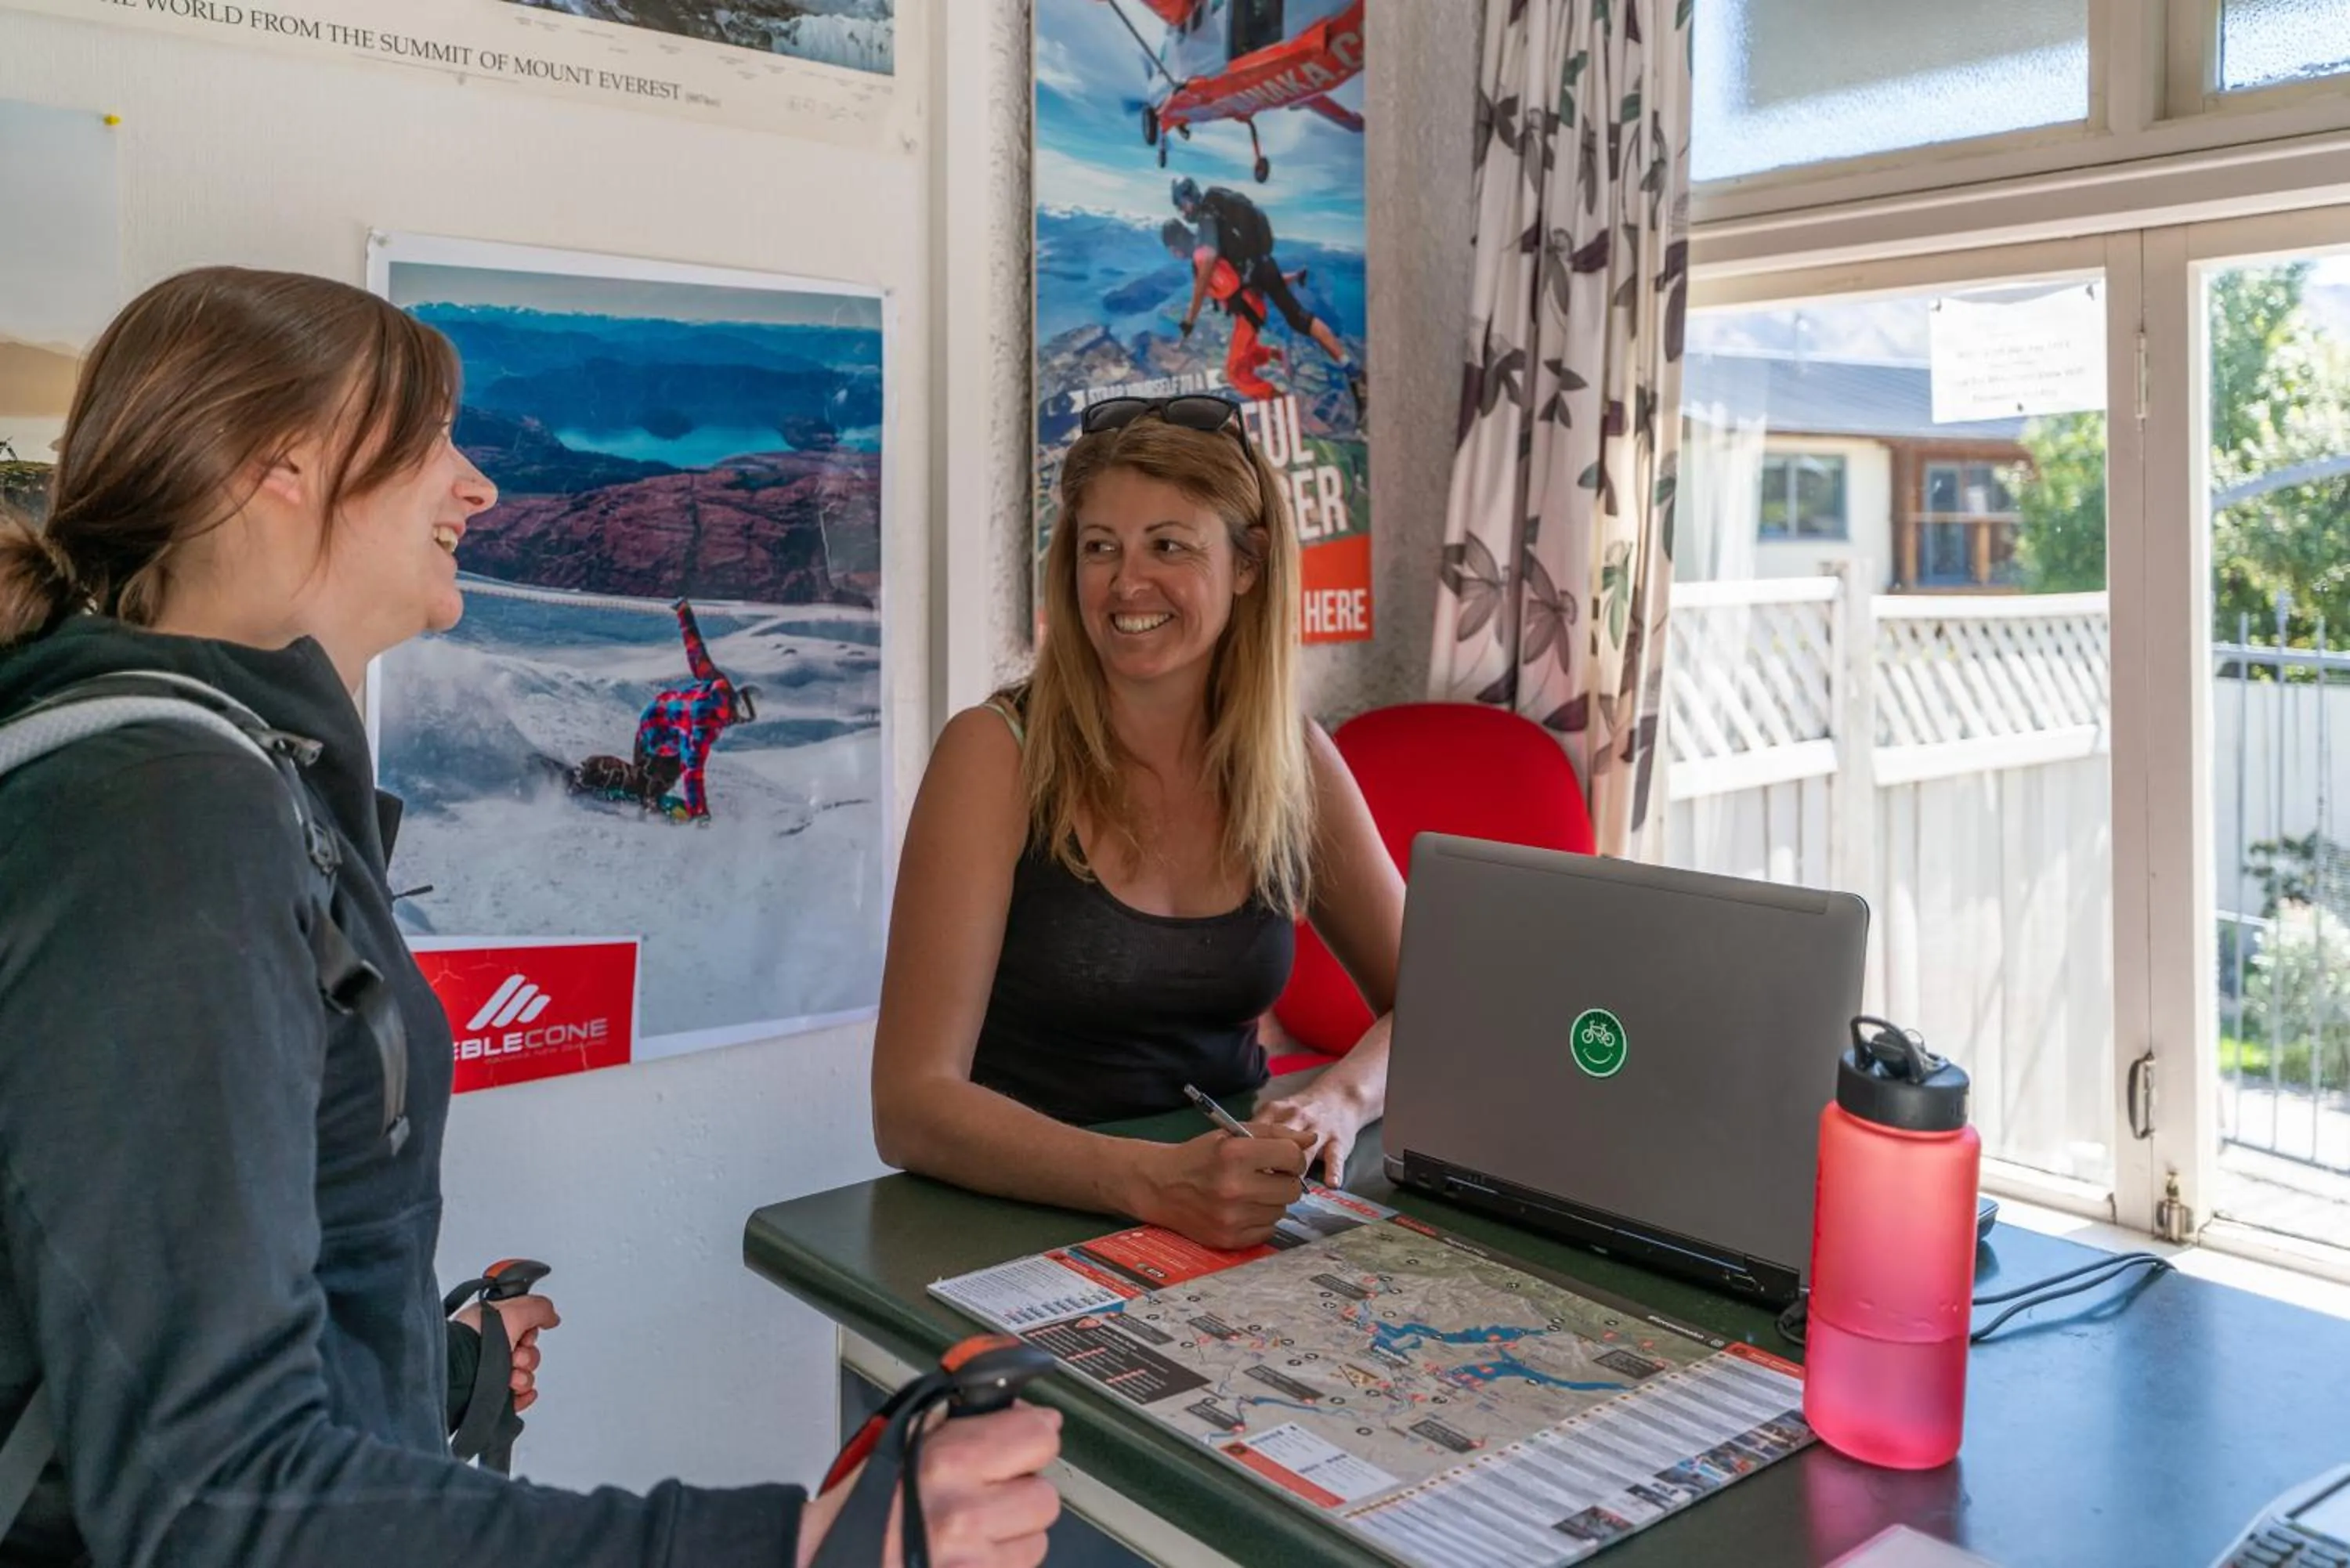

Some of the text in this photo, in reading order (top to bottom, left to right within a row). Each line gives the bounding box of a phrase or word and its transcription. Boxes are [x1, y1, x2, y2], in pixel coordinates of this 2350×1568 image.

[146, 0, 244, 25] WORLD
[250, 9, 321, 40] FROM
[326, 22, 375, 49] THE
[379, 33, 473, 66] SUMMIT
[479, 50, 509, 70] OF
[513, 56, 595, 86] MOUNT
[598, 70, 682, 101] EVEREST
[1303, 588, 1368, 633] HERE
[454, 1017, 609, 1061] BLECONE
